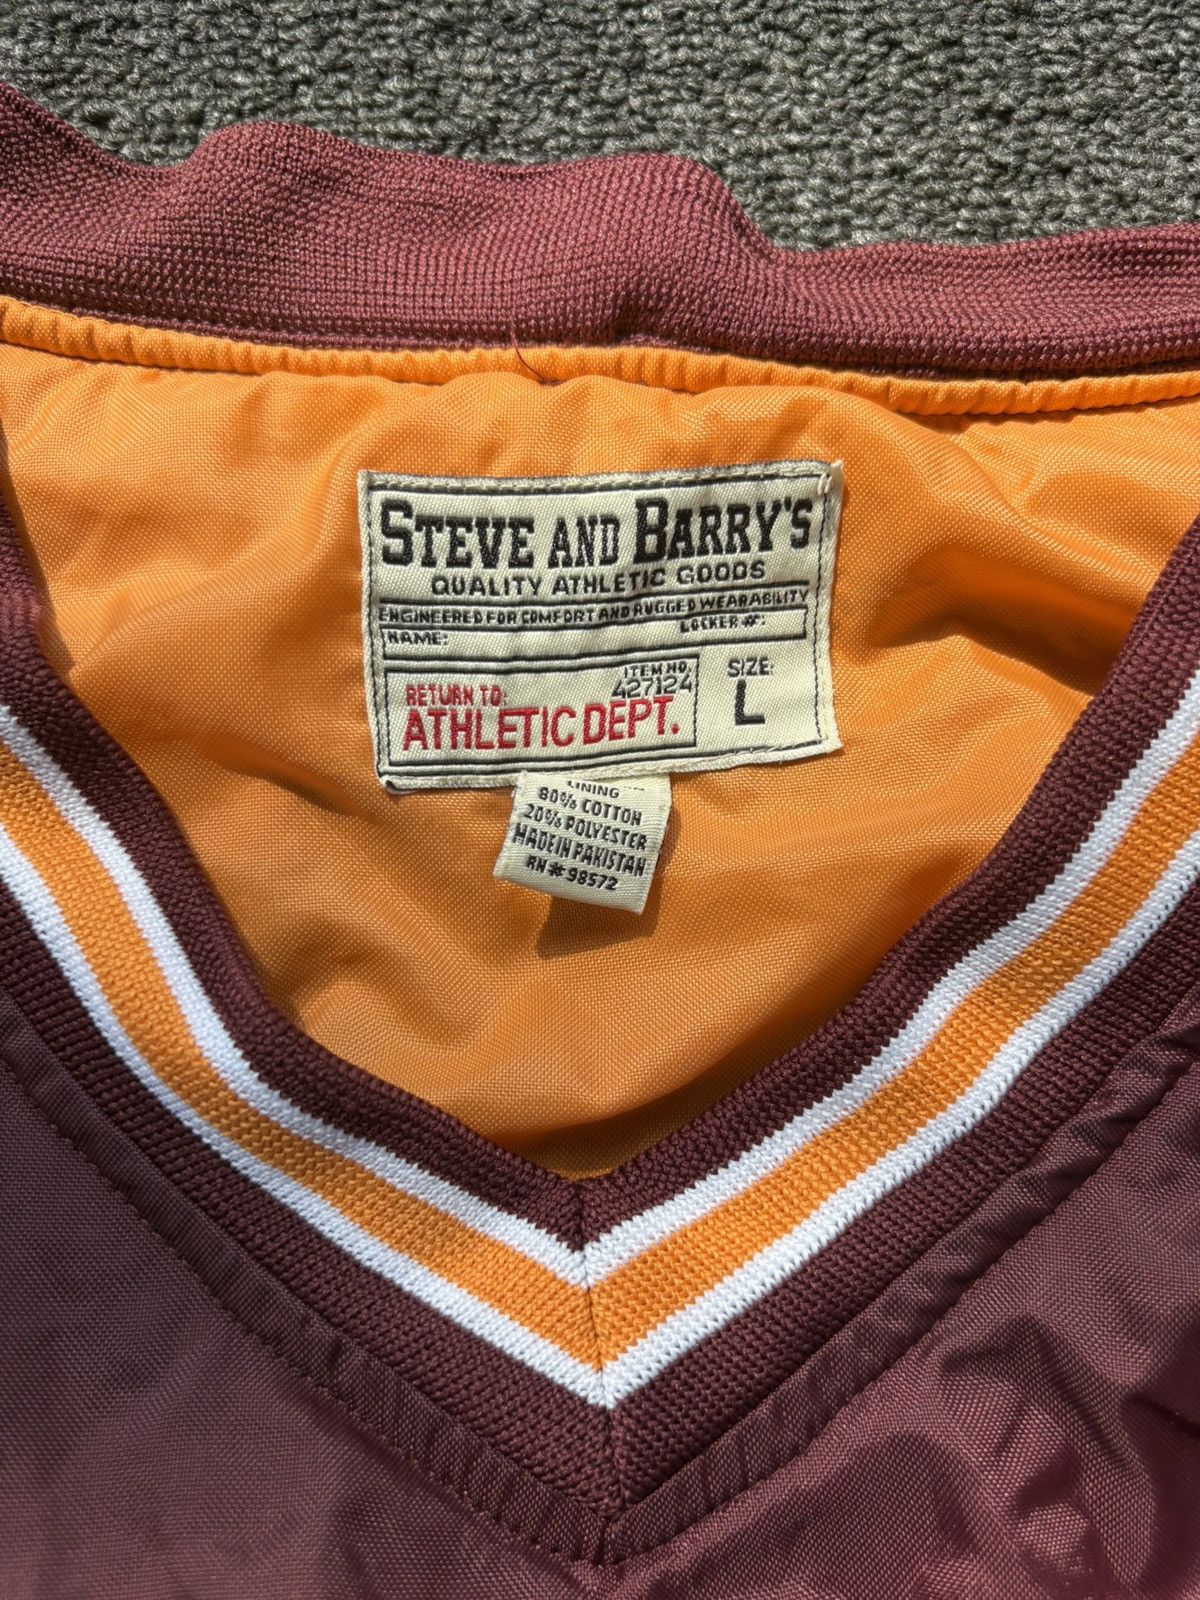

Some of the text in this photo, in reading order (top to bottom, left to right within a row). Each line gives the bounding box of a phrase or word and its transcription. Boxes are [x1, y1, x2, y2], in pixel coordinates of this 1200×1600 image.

[381, 497, 813, 569] STEVE AND BARRY'S
[431, 560, 766, 596] QUALITY ATHLETIC GOODS
[379, 589, 809, 624] ENGINEERED FOR COMFORT AND RUGGED WEARABILITY
[680, 614, 738, 633] LOCKER
[387, 631, 449, 646] NAME:
[624, 664, 664, 679] ITEM
[727, 656, 774, 678] SIZE:
[405, 683, 474, 707] RETURN
[611, 671, 693, 700] 427124
[734, 679, 766, 727] L
[402, 695, 681, 751] ATHLETIC DEPT.
[538, 786, 643, 827] 80% COTTON
[523, 803, 648, 851] 20% POLYESTER
[512, 822, 647, 877] MADE IN PAKISTAN
[526, 854, 547, 873] RN
